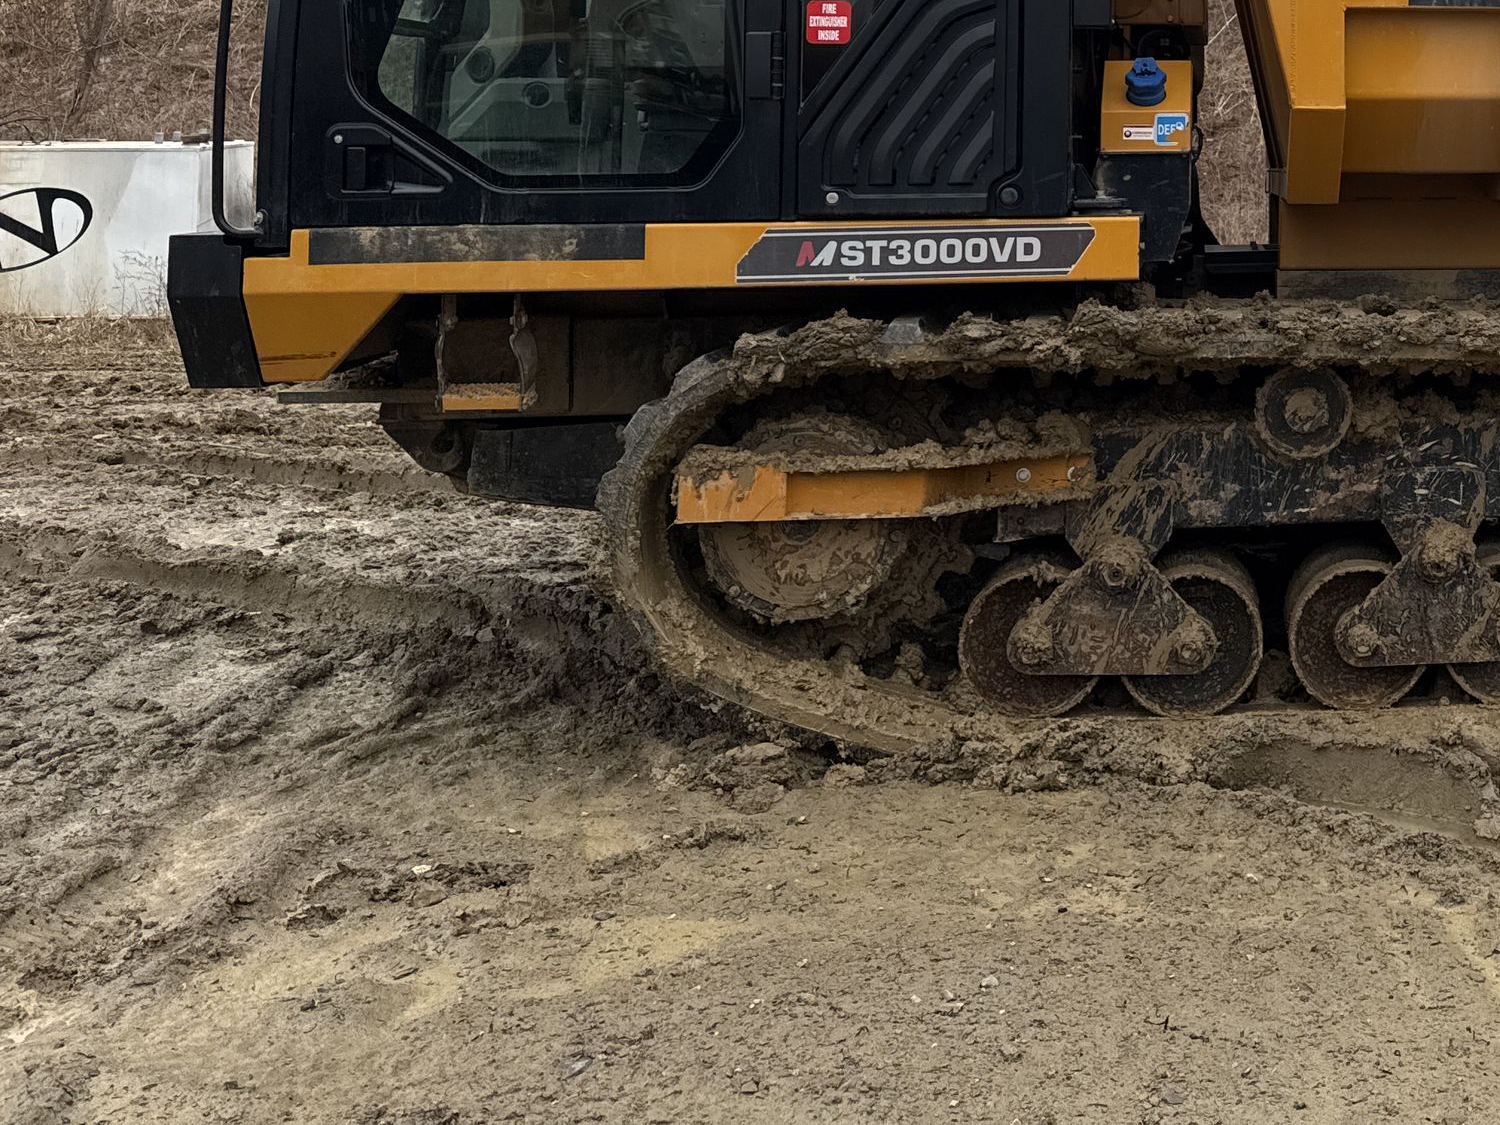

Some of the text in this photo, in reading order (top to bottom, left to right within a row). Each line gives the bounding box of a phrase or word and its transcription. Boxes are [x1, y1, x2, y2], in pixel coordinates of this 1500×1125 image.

[822, 3, 837, 14] FIRE
[809, 16, 847, 27] EXTINGUISHER
[817, 30, 840, 41] INSIDE
[795, 237, 1042, 267] MST3000VD
